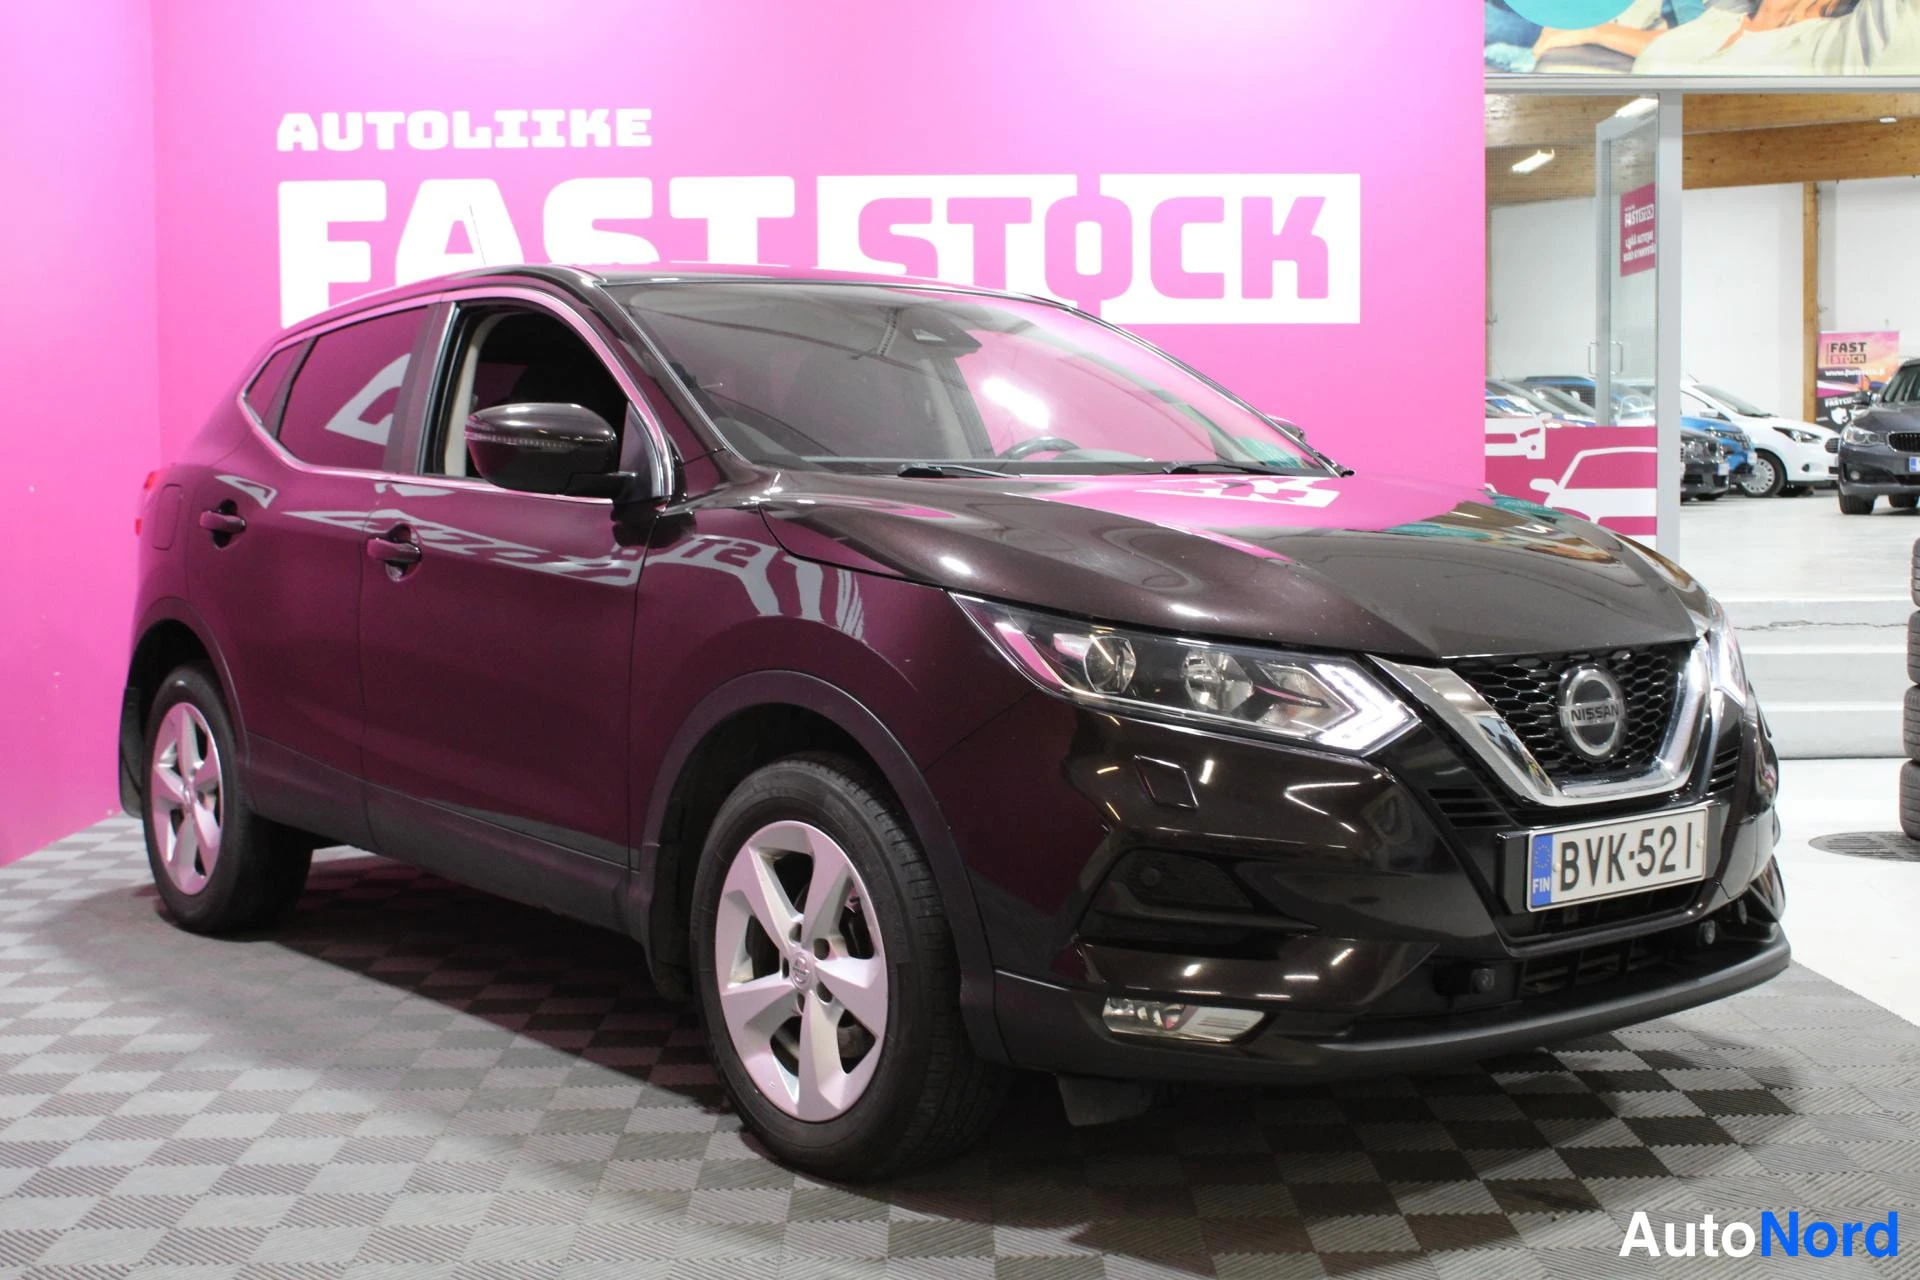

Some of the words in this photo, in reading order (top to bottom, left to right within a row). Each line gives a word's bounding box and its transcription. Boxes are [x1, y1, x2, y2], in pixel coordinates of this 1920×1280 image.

[276, 108, 652, 152] AUTOLIIKE
[856, 195, 1329, 301] STOCK
[1830, 342, 1867, 353] FAST
[1570, 703, 1619, 721] NISSAN
[1532, 876, 1550, 895] FIN
